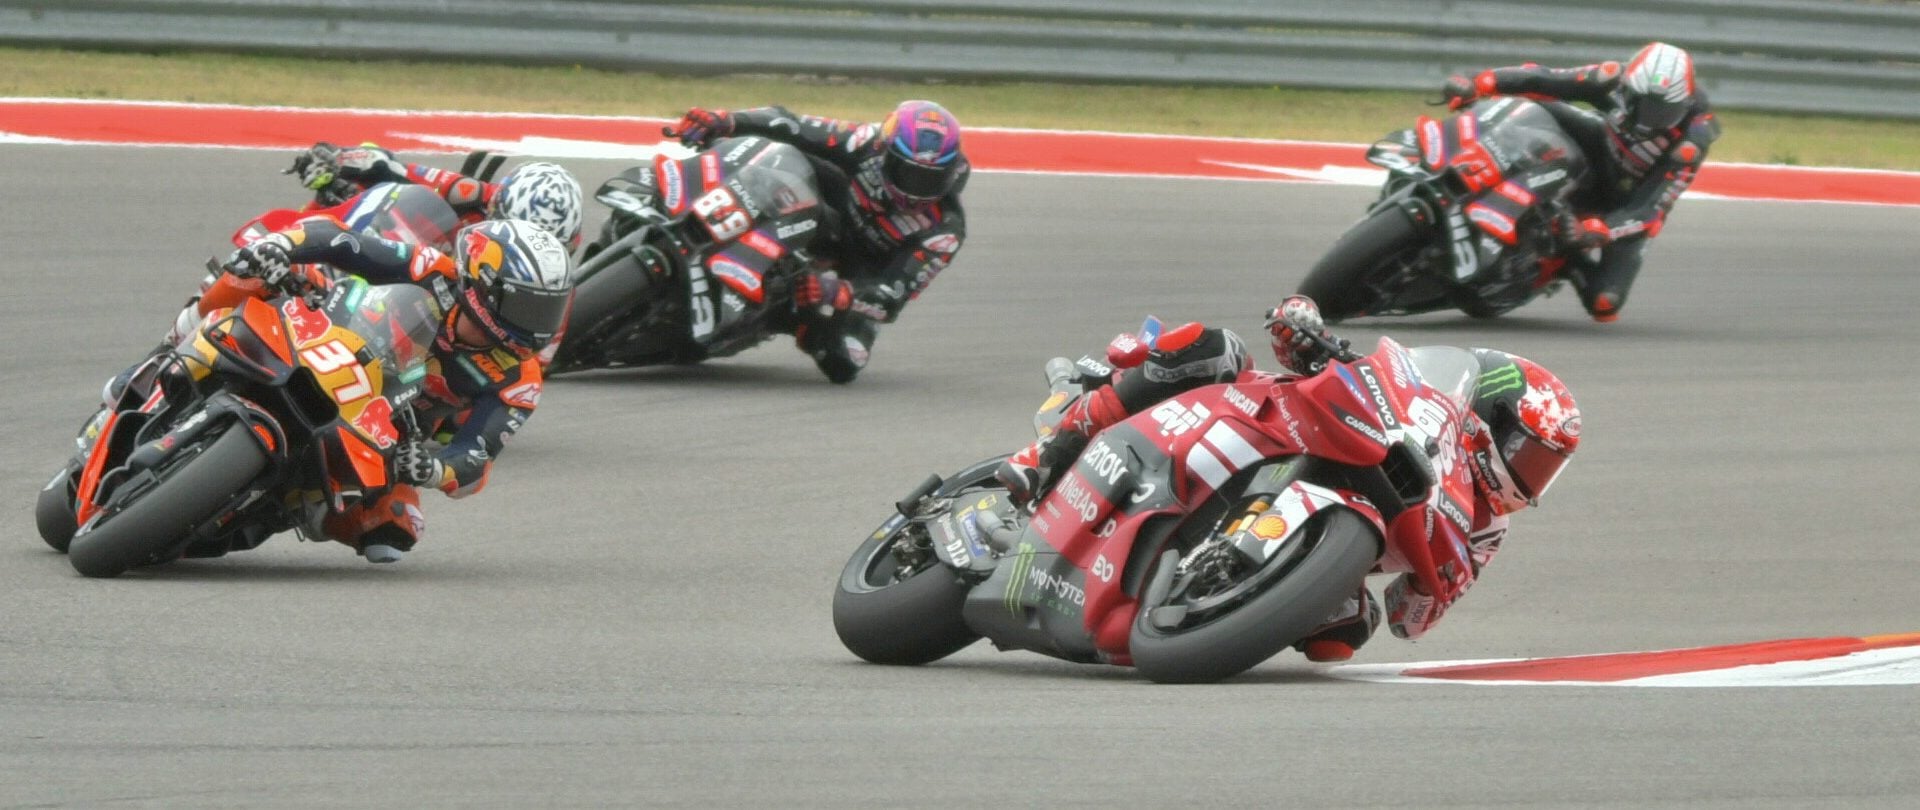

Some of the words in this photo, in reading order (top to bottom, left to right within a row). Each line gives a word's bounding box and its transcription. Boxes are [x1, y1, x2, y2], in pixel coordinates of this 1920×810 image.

[694, 188, 749, 240] 89
[300, 340, 373, 404] 37
[1076, 354, 1111, 376] Lenovo
[1223, 384, 1260, 417] DUCATI
[1359, 366, 1395, 426] Lenovo
[1277, 396, 1292, 422] Audi
[1288, 421, 1309, 453] Sport
[1344, 415, 1389, 446] CARRERA
[1476, 451, 1498, 488] Lenovo
[1440, 494, 1470, 533] Lenovo
